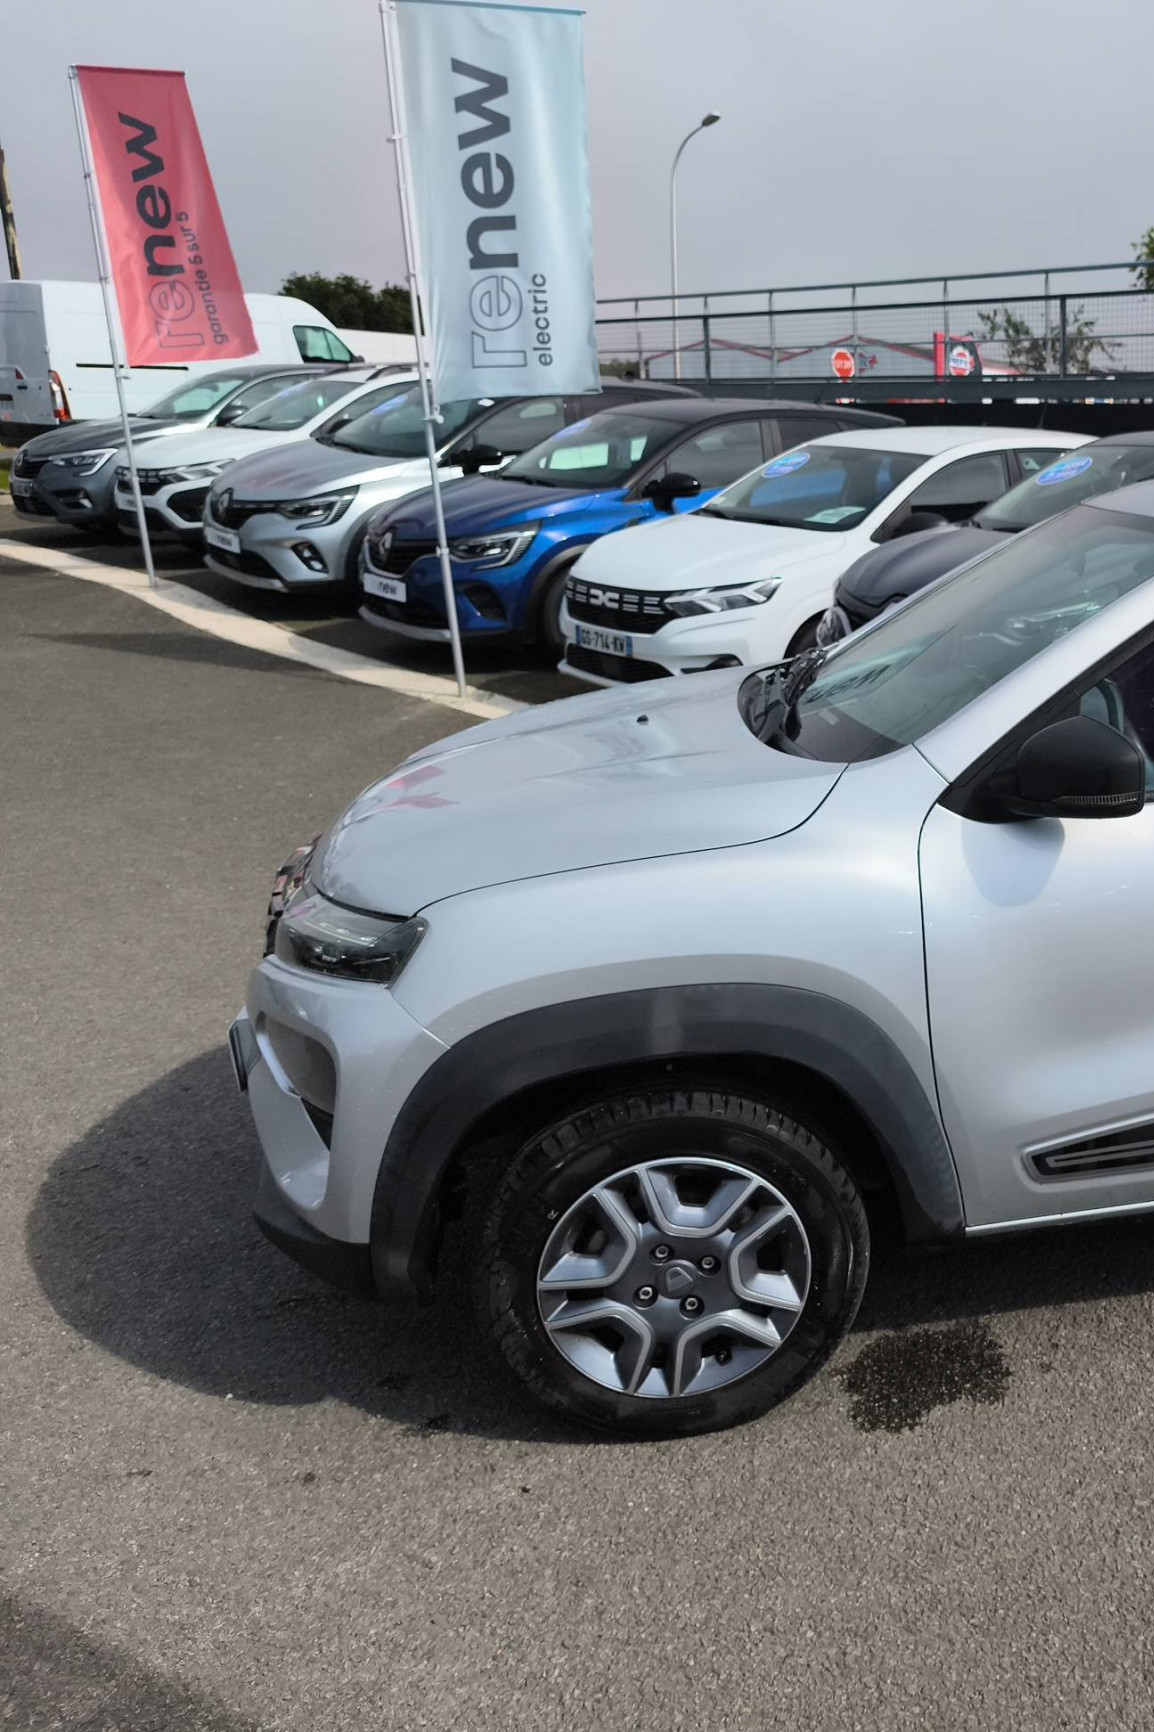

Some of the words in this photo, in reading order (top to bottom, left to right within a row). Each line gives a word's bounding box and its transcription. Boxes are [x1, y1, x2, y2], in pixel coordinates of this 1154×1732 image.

[117, 111, 205, 349] renew
[180, 225, 200, 252] sur
[450, 57, 528, 368] renew
[194, 269, 229, 345] garantie
[528, 272, 554, 367] electric
